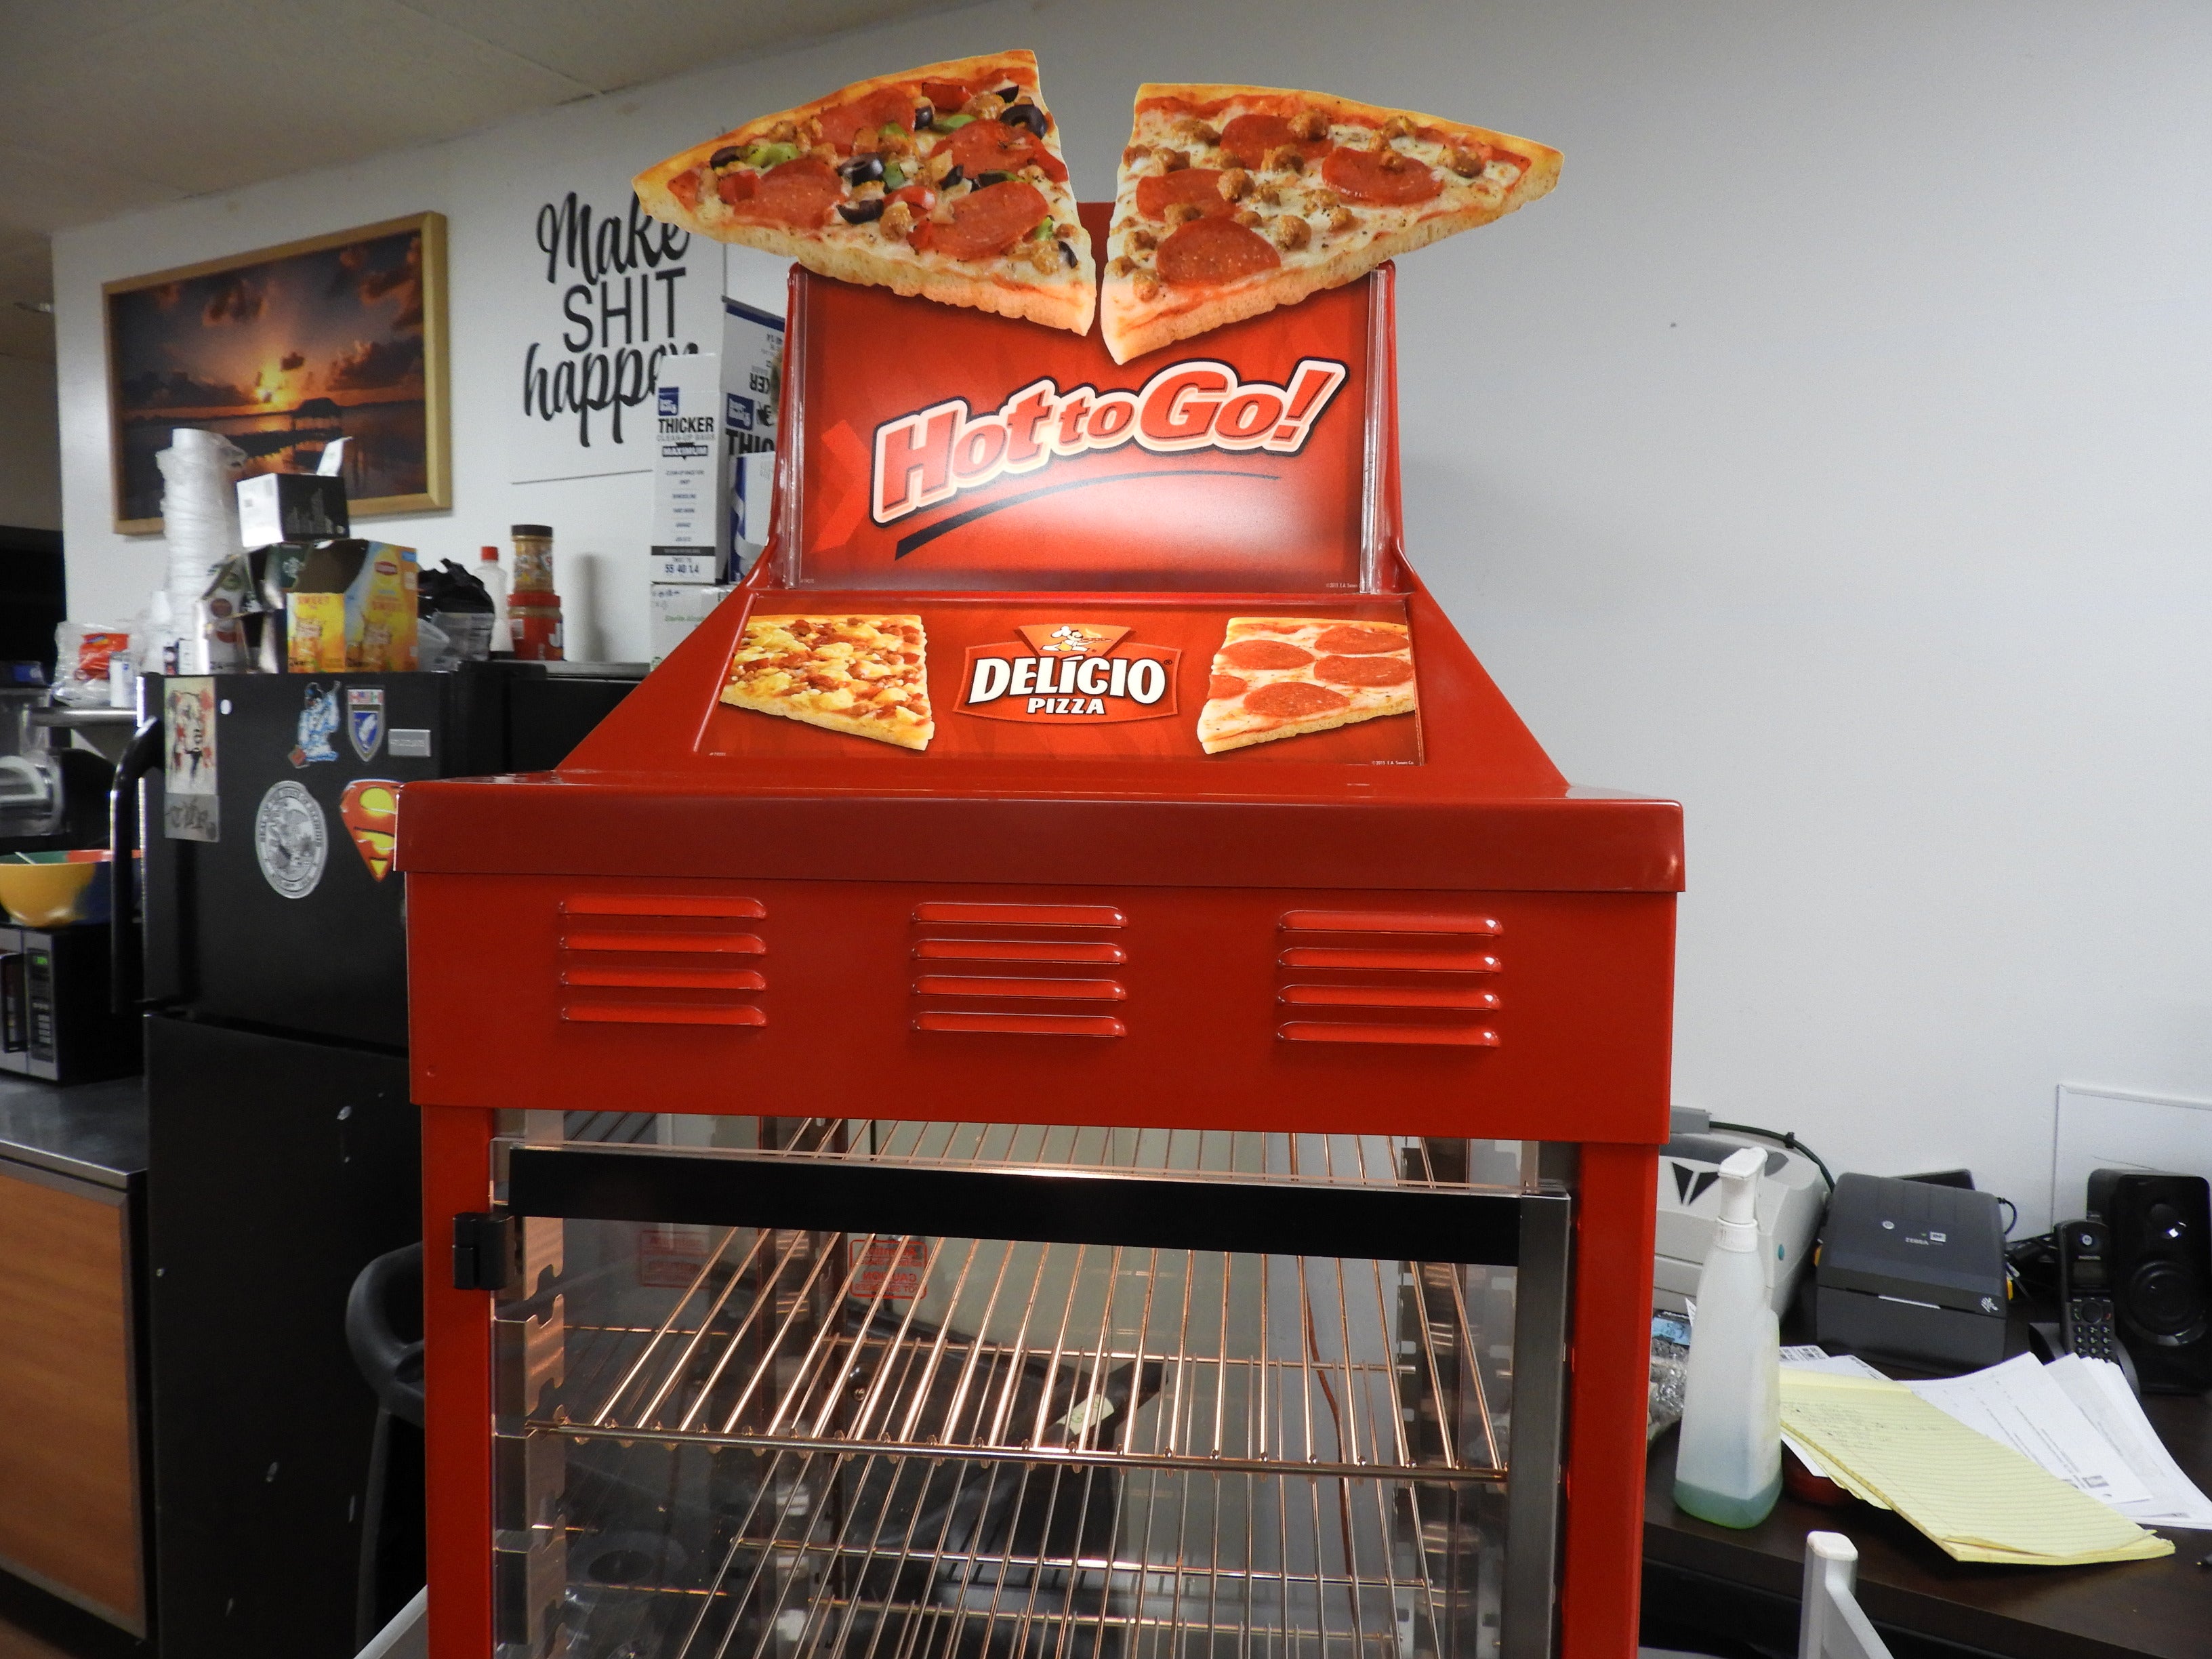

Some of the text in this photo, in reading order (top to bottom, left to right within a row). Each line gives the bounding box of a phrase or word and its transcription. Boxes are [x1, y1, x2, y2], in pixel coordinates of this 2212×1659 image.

[537, 190, 690, 285] Make
[562, 267, 687, 353] SHIT
[658, 417, 714, 433] THICKER
[876, 365, 1343, 519] Hot to Go!
[1026, 697, 1106, 715] PIZZA
